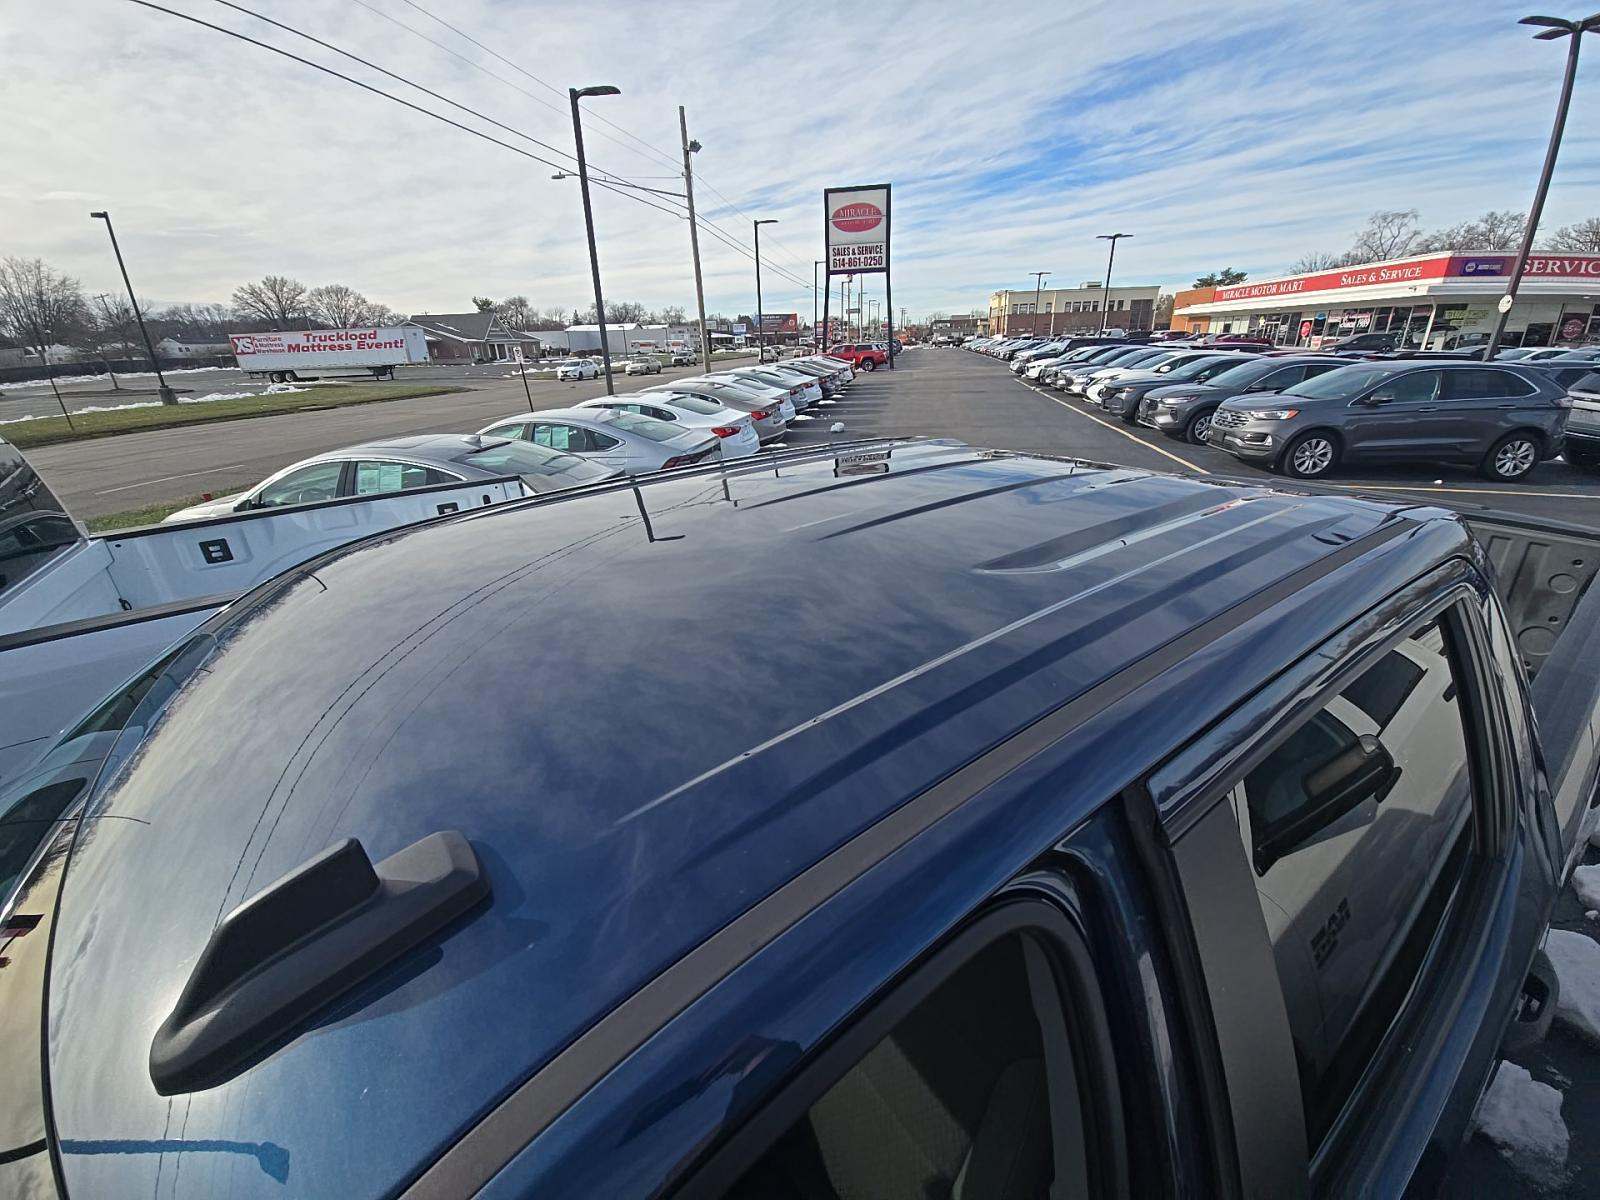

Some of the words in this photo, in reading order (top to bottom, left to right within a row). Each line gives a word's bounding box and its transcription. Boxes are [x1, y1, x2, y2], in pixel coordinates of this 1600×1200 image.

[840, 207, 878, 217] MIRACLE
[832, 247, 850, 257] SALES
[851, 248, 857, 256] &
[857, 245, 883, 256] SERVICE
[832, 255, 883, 268] 614-861-0250
[1340, 273, 1367, 286] SALES
[1368, 273, 1377, 282] &
[1378, 266, 1423, 281] SERVICE
[1222, 288, 1250, 300] MIRACLE
[1250, 284, 1277, 297] MOTOR
[1278, 280, 1305, 293] MART
[303, 330, 377, 342] Truckload
[233, 337, 254, 354] XS
[287, 340, 352, 353] Mattress
[356, 339, 404, 350] Event!
